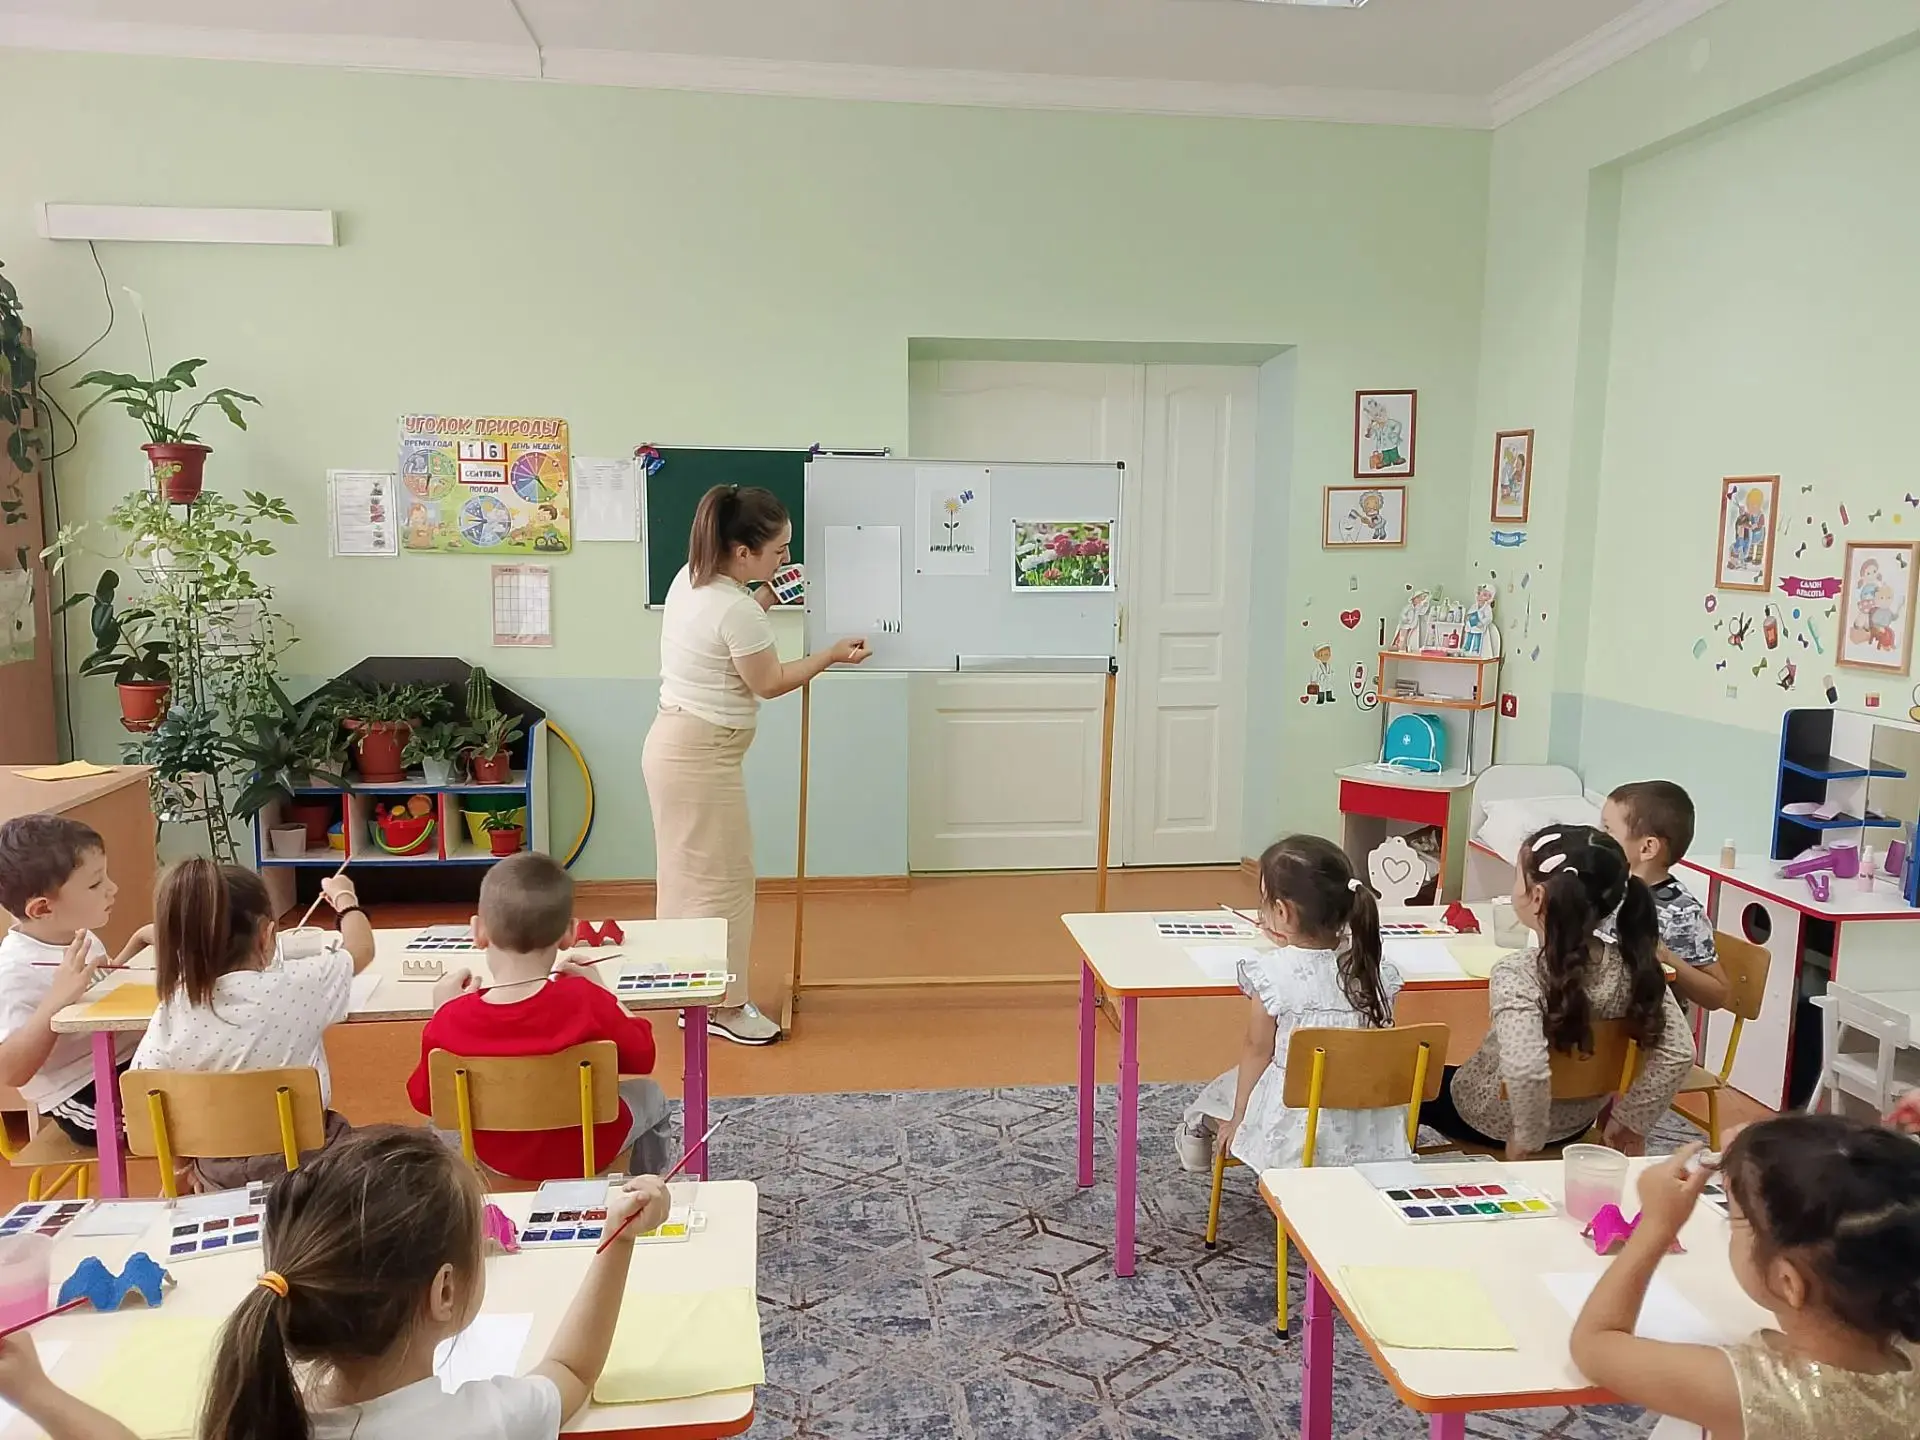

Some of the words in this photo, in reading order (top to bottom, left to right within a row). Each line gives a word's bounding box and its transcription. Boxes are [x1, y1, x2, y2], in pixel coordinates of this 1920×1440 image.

[405, 417, 472, 434] УГОЛОК
[474, 418, 560, 438] ПРИРОДЫ
[433, 440, 453, 448] ГОДА
[511, 442, 531, 450] ДЕНЬ
[533, 443, 562, 451] НЕДЕЛИ
[464, 470, 502, 478] СЕНТЯБРЬ
[469, 486, 499, 494] ПОГОДА
[1800, 580, 1822, 588] САЛОН
